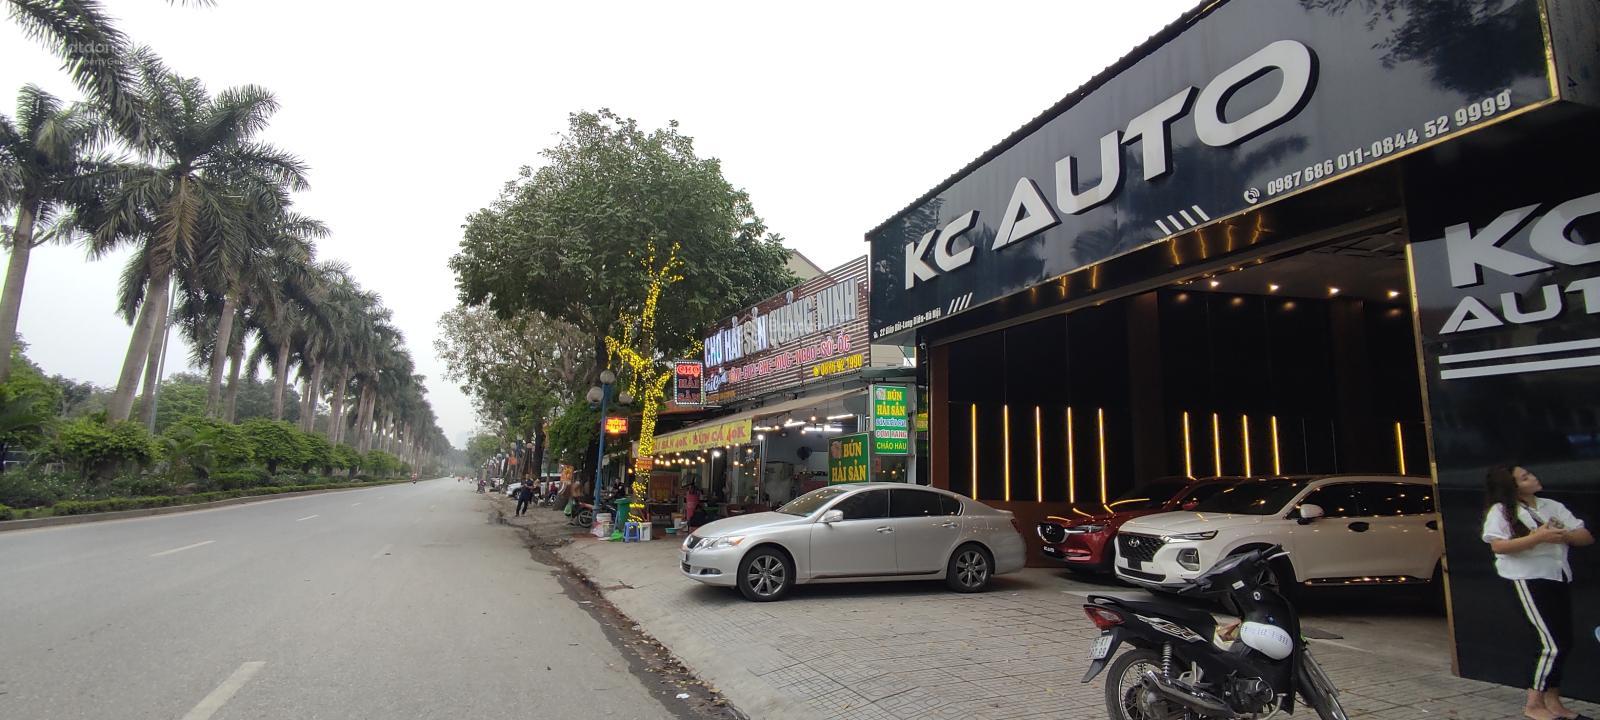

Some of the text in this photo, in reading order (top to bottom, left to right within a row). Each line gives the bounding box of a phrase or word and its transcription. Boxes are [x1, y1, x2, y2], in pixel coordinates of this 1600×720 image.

[1267, 89, 1512, 196] 0987 686 011-0844 52 9999
[905, 39, 1318, 290] KC AUTO
[816, 277, 856, 331] NINH
[727, 426, 746, 443] 40K
[843, 439, 862, 457] BÚN
[831, 459, 866, 482] HẢI SẢN
